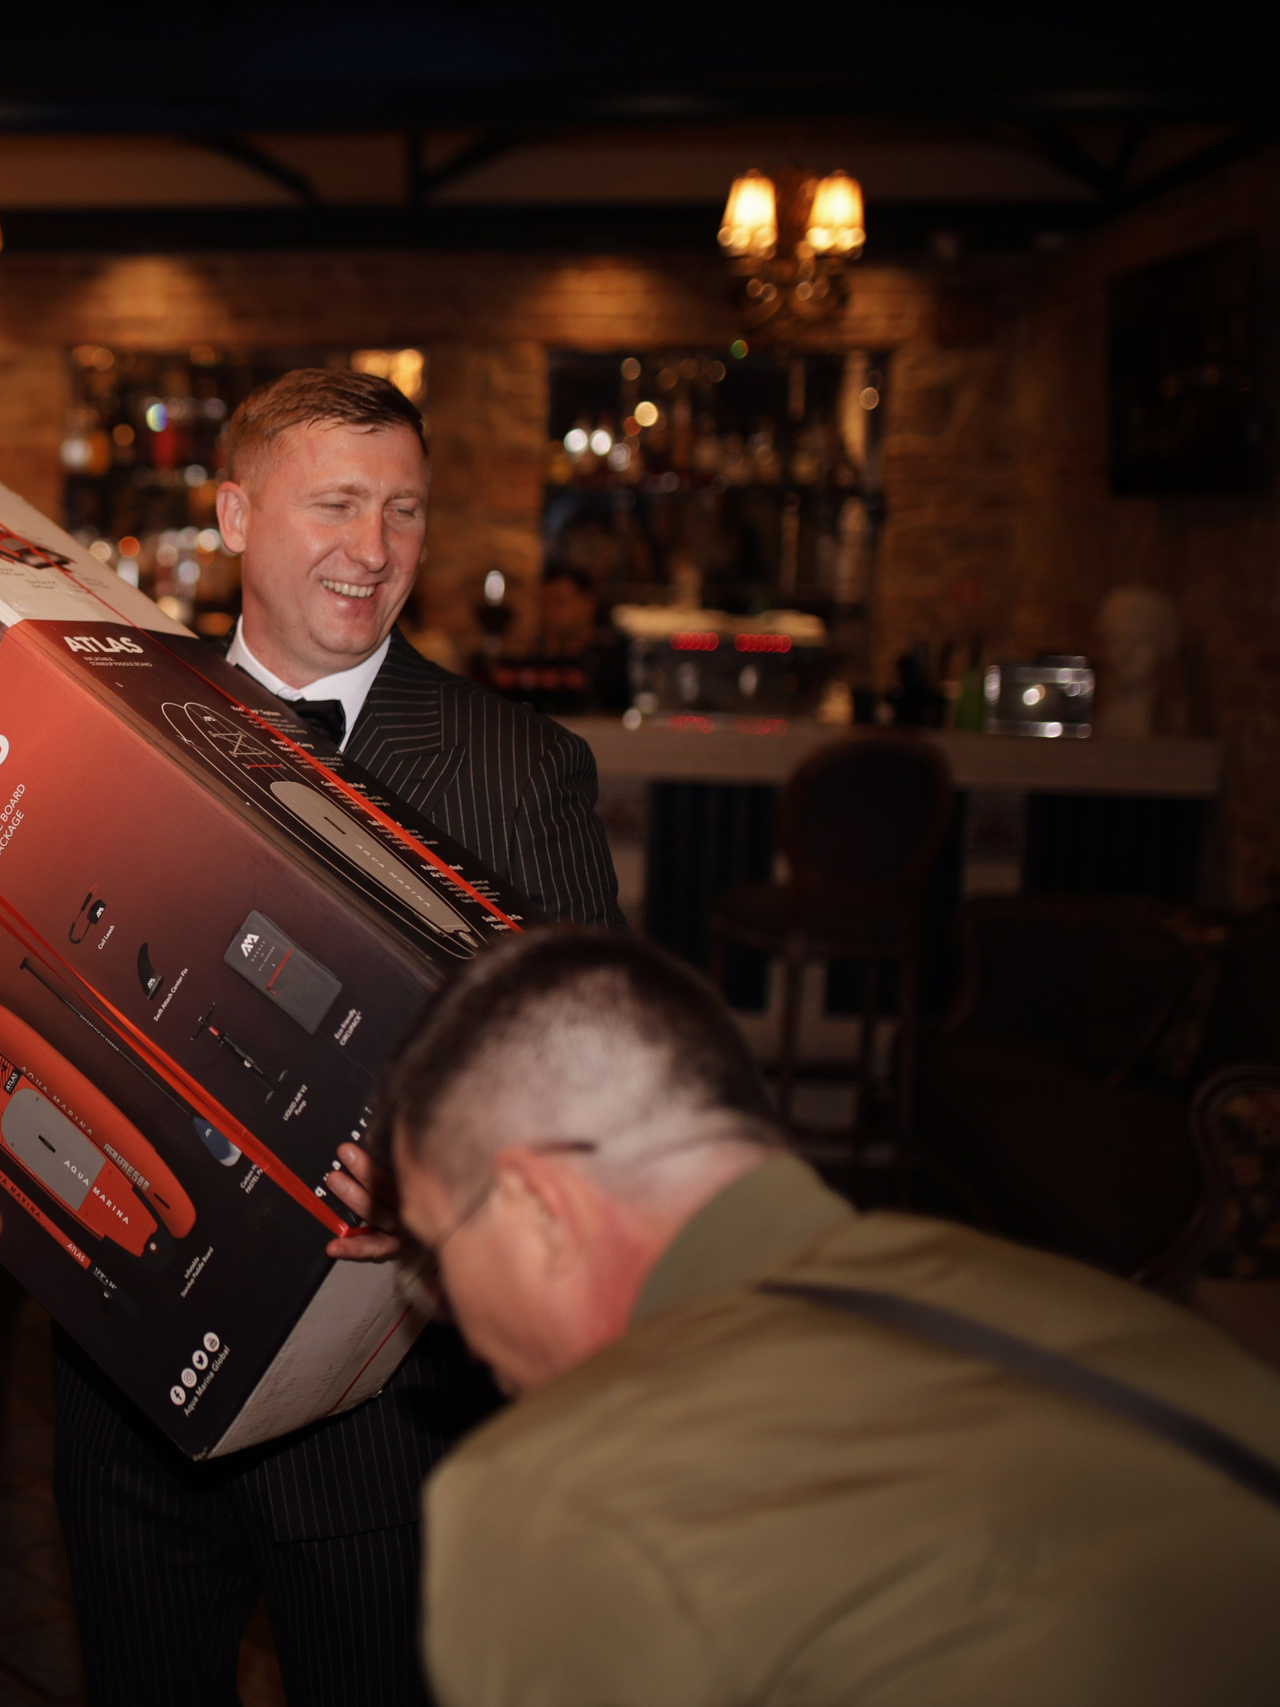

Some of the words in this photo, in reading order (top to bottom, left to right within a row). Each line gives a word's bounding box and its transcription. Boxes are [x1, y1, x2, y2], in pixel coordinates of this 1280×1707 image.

[63, 636, 144, 653] ATLAS
[0, 783, 26, 823] BOARD
[6, 1072, 18, 1091] ATLAS
[64, 1160, 89, 1186] AQUA
[92, 1186, 129, 1224] MARINA
[67, 1243, 85, 1262] ATLAS
[184, 1396, 198, 1417] Aqua
[195, 1371, 214, 1397] Marina
[211, 1345, 230, 1371] Global
